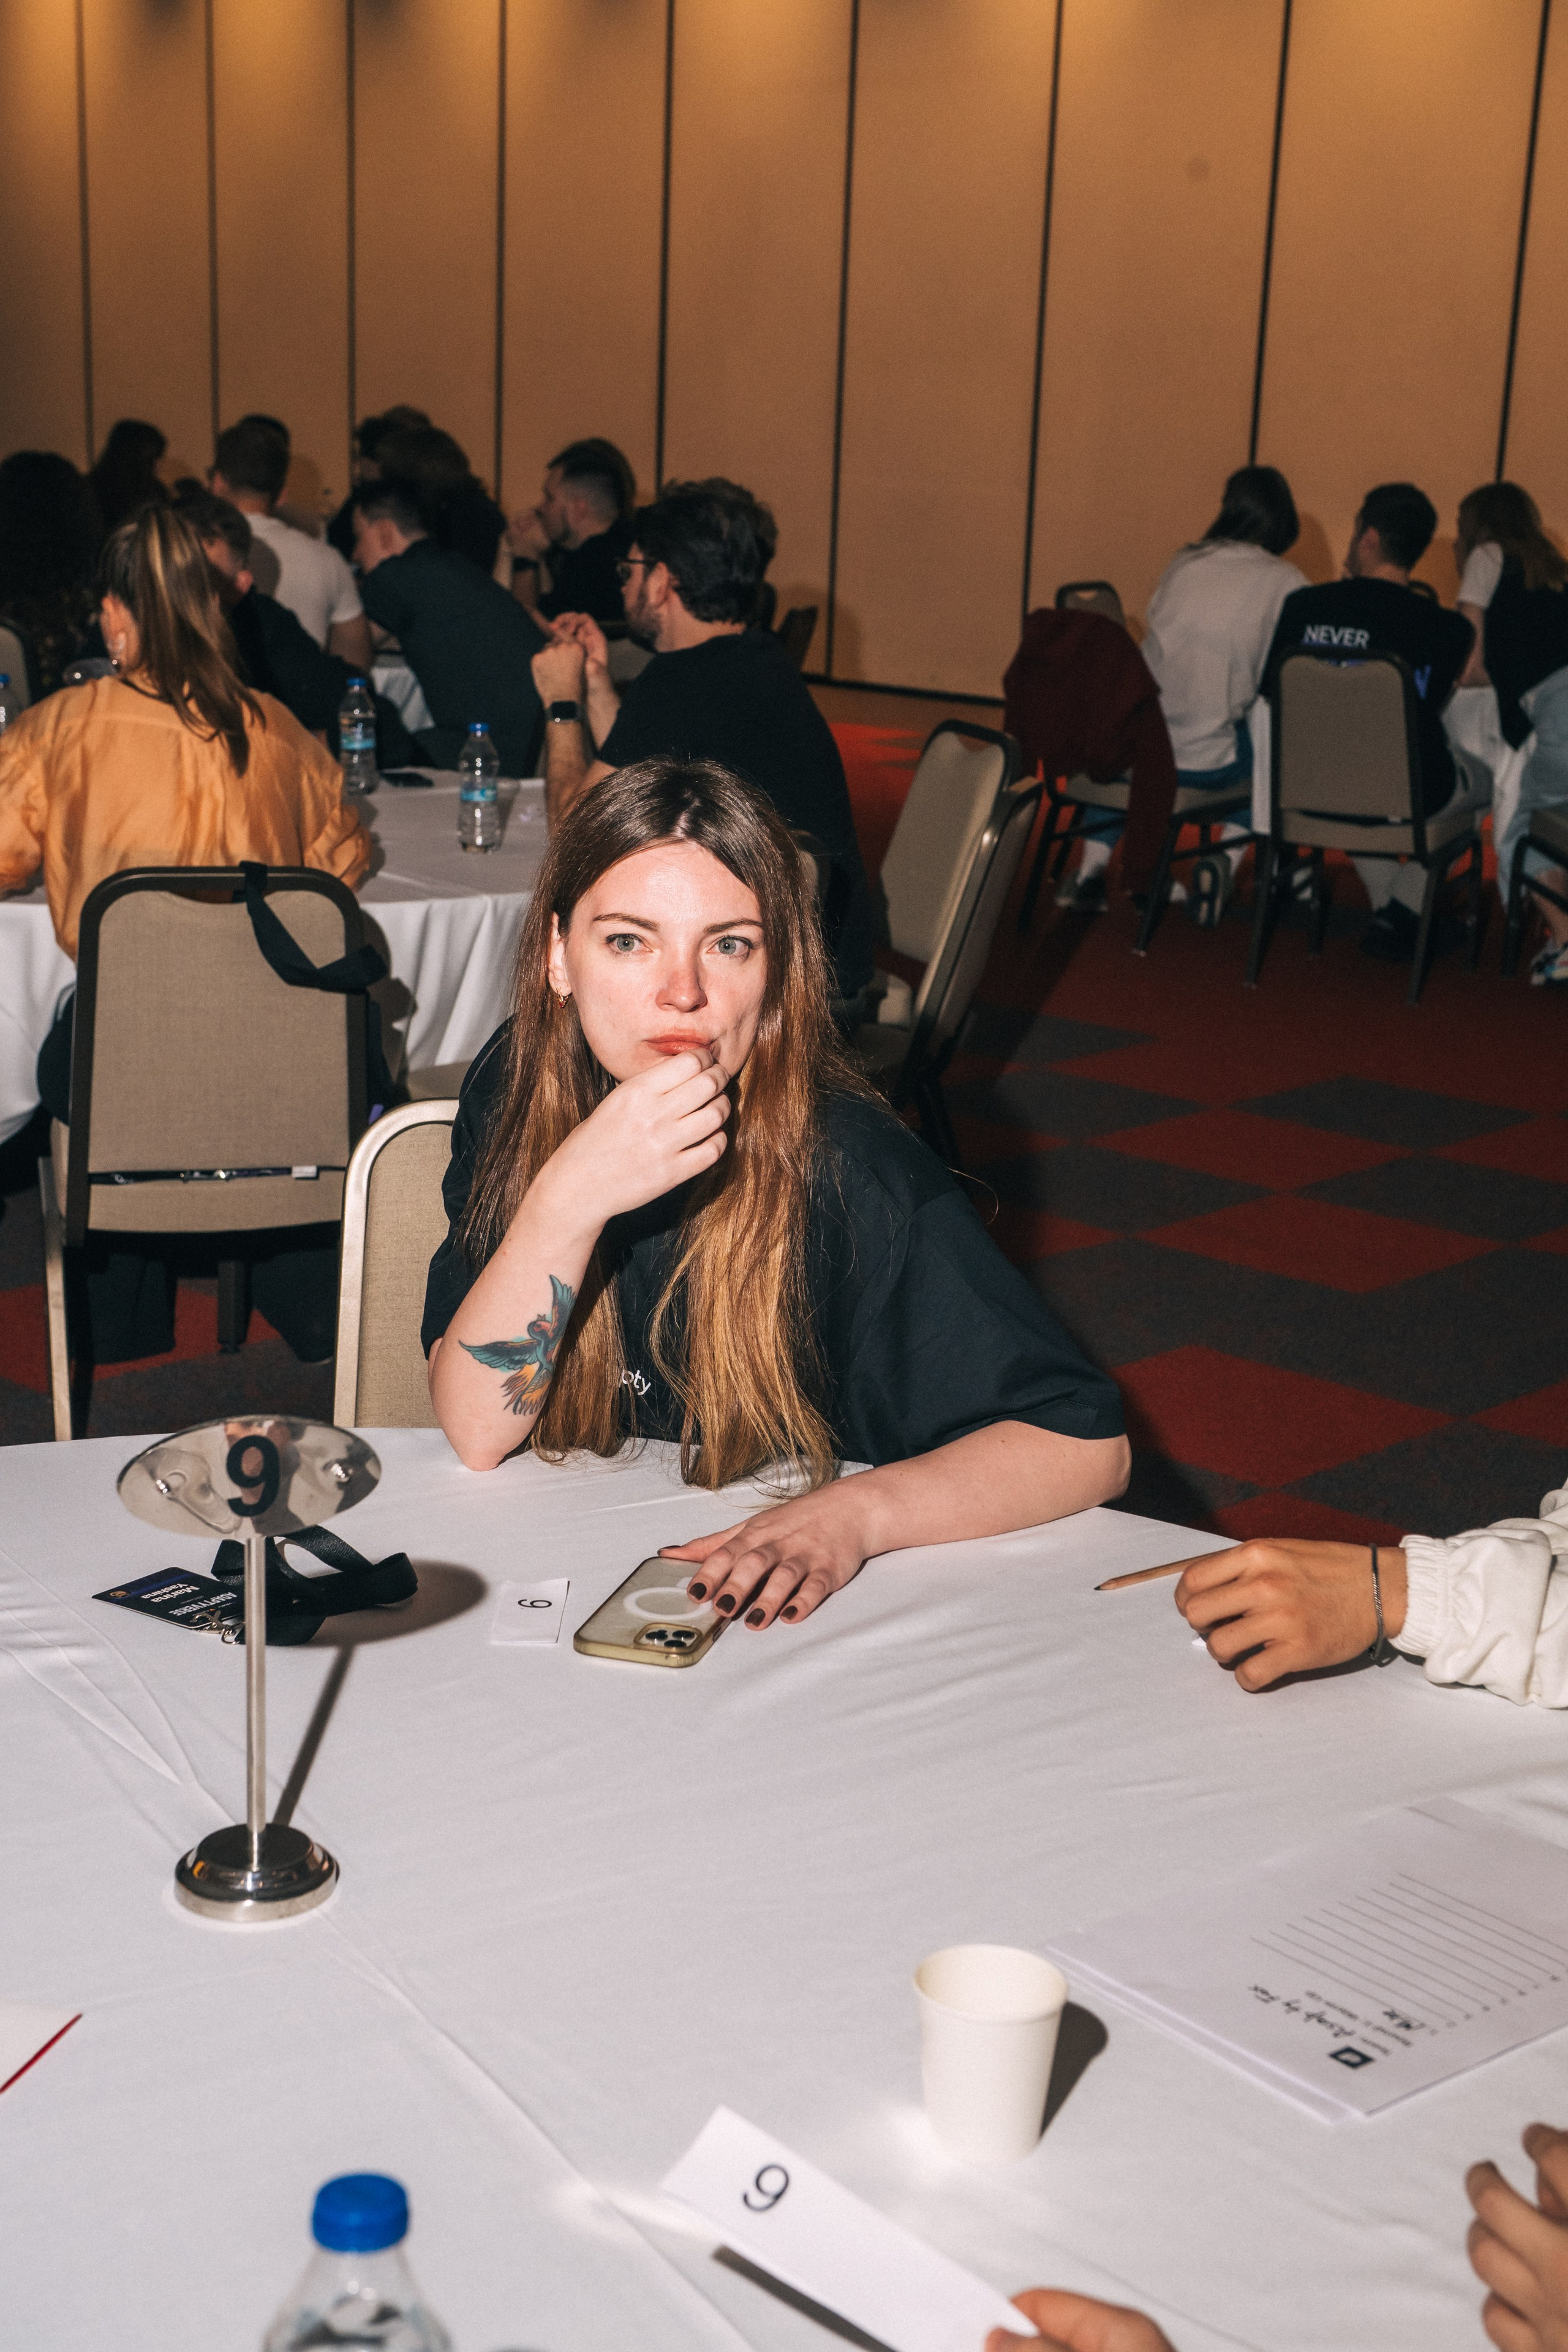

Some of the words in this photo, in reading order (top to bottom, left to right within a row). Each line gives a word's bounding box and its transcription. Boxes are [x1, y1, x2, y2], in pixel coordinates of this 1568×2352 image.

[1302, 624, 1371, 650] NEVER
[619, 1369, 652, 1395] pty
[226, 1434, 280, 1517] 9
[141, 1583, 189, 1599] Yashina
[150, 1585, 200, 1603] Marina
[168, 1591, 238, 1616] ADAPTYVERSE
[517, 1599, 552, 1608] 9
[742, 2163, 790, 2213] 9
